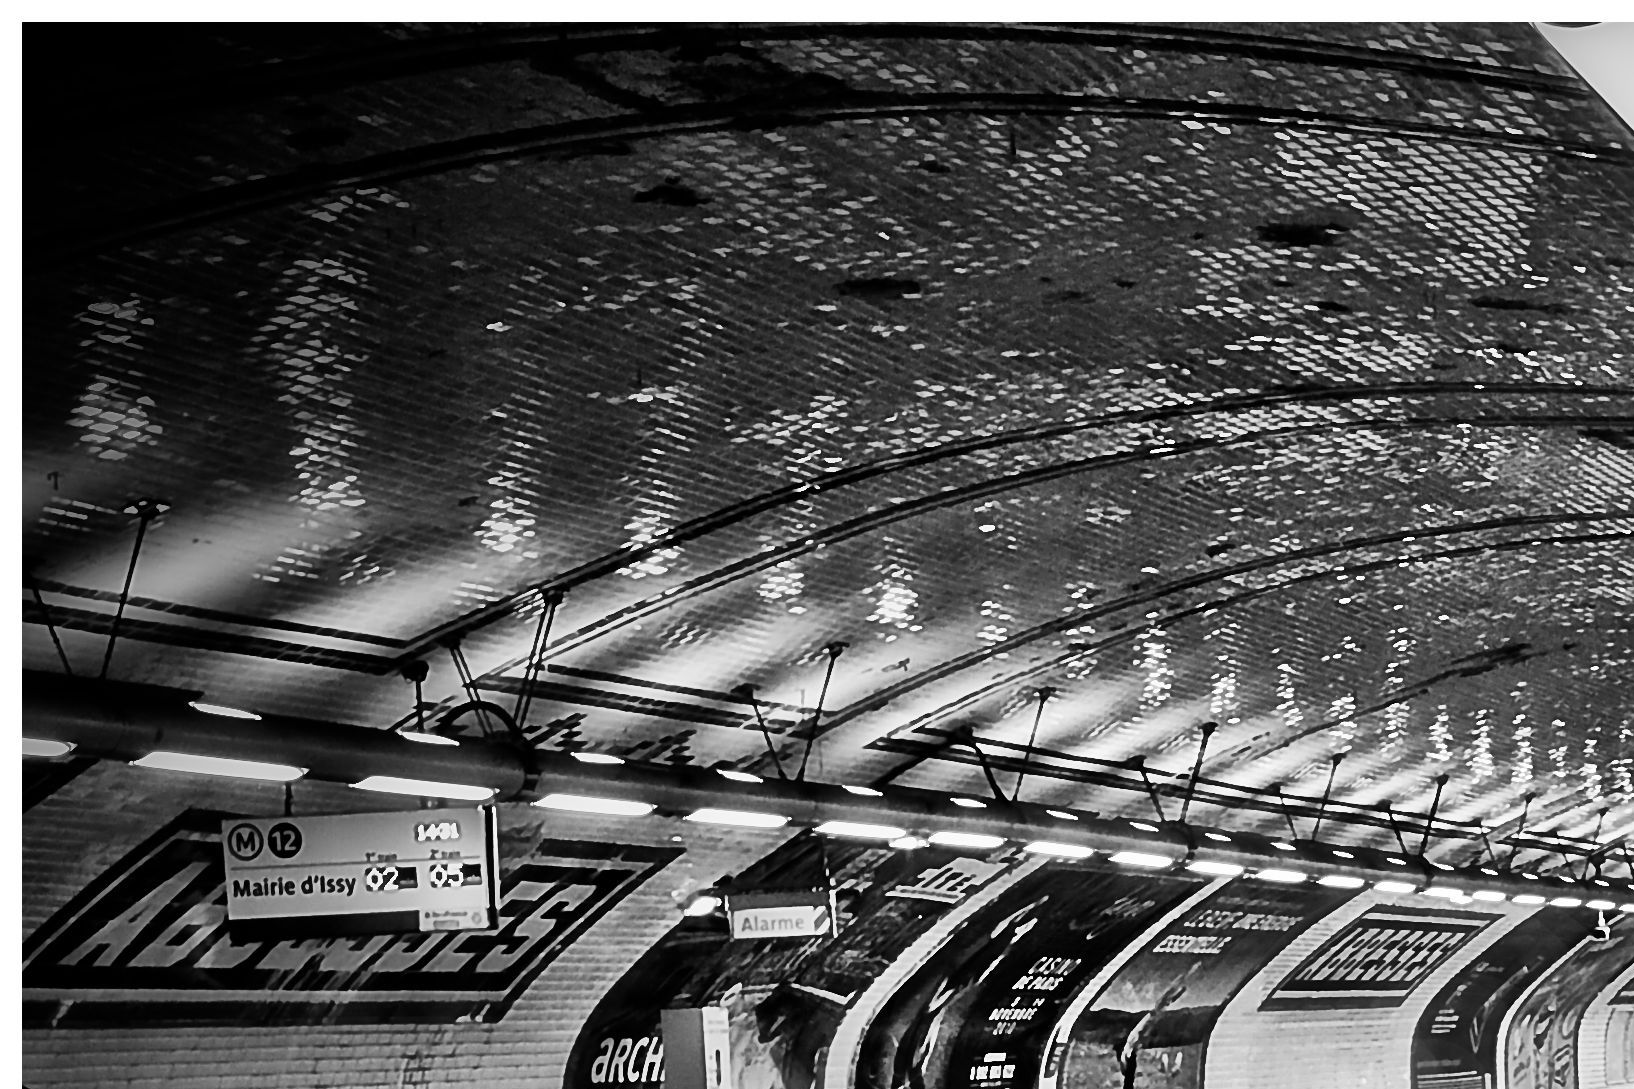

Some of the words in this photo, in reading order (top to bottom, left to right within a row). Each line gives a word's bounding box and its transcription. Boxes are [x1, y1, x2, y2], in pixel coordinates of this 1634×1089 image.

[271, 831, 296, 851] 12
[233, 877, 295, 898] Mairie
[301, 875, 356, 896] d'Issy
[365, 867, 399, 891] 02
[430, 863, 464, 887] 05
[741, 914, 805, 932] Alarme
[1295, 928, 1466, 981] ABBESSES
